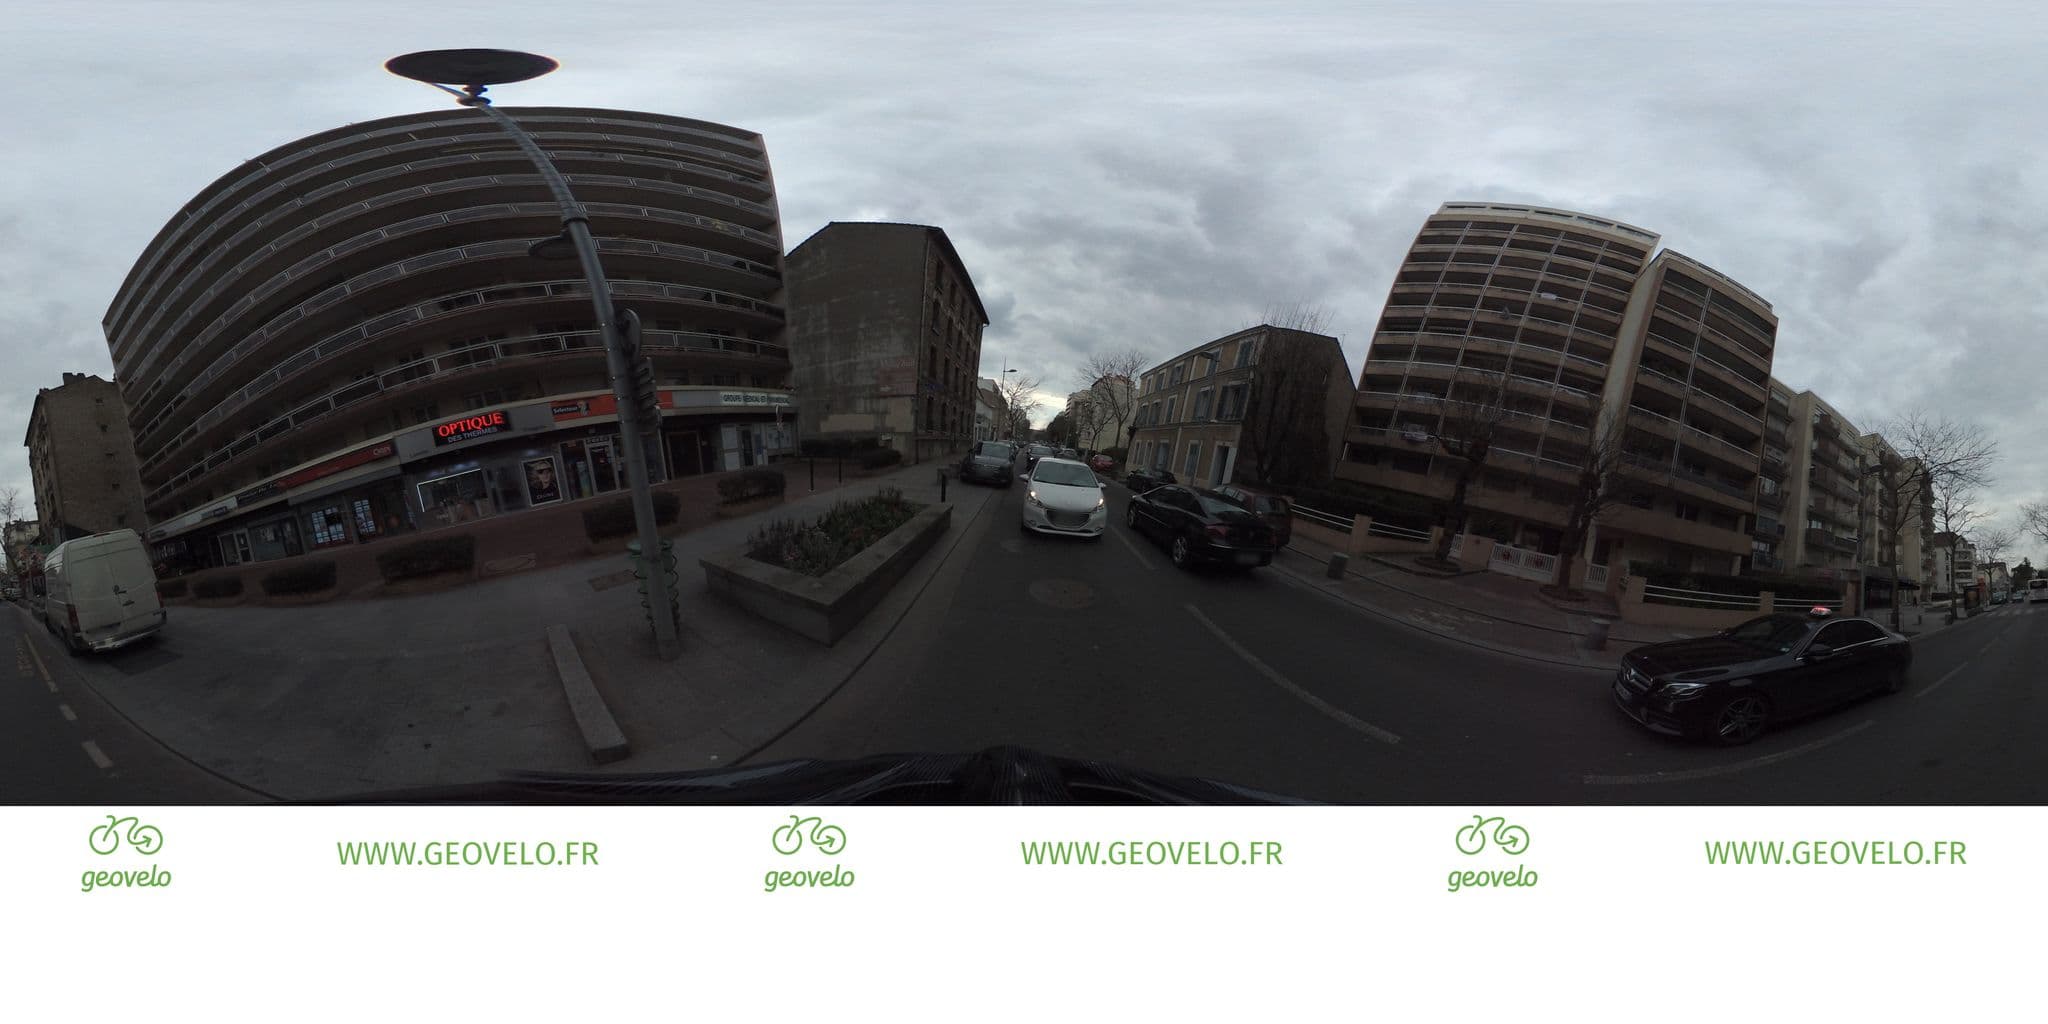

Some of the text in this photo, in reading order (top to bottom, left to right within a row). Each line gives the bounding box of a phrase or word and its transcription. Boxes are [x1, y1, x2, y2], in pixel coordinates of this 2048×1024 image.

[438, 412, 504, 437] OPTIQUE
[447, 427, 498, 443] DES THERMES
